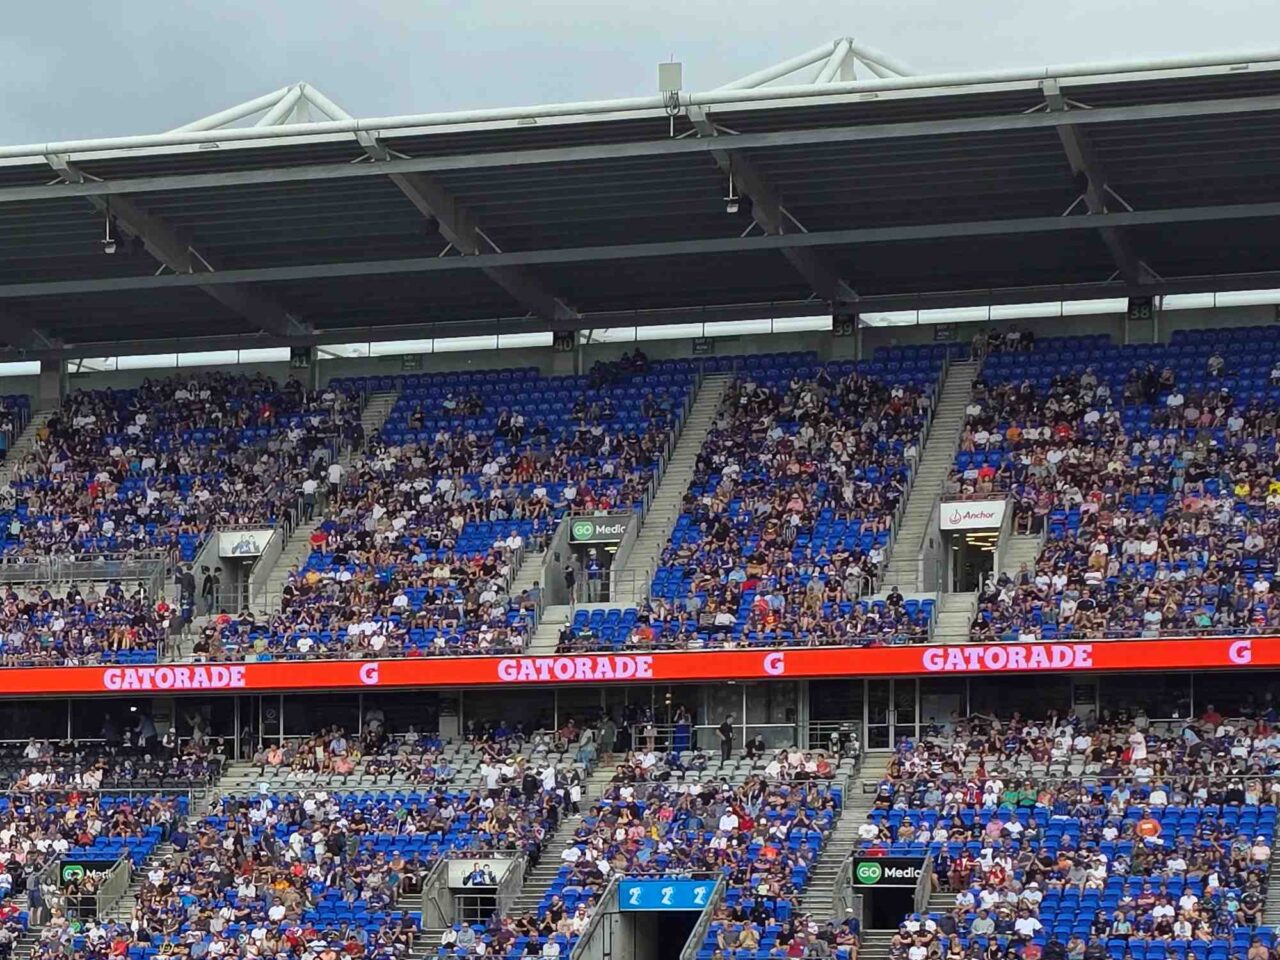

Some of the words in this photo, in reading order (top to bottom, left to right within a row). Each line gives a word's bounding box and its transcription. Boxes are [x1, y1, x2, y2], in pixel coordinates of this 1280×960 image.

[963, 511, 994, 520] Anchor
[575, 525, 592, 534] GO
[763, 652, 784, 676] G
[922, 644, 1093, 671] GATORADE
[1229, 640, 1252, 664] G
[103, 666, 246, 691] GATORADE
[360, 662, 379, 684] G
[497, 656, 653, 681] GATORADE
[859, 866, 880, 878] GO
